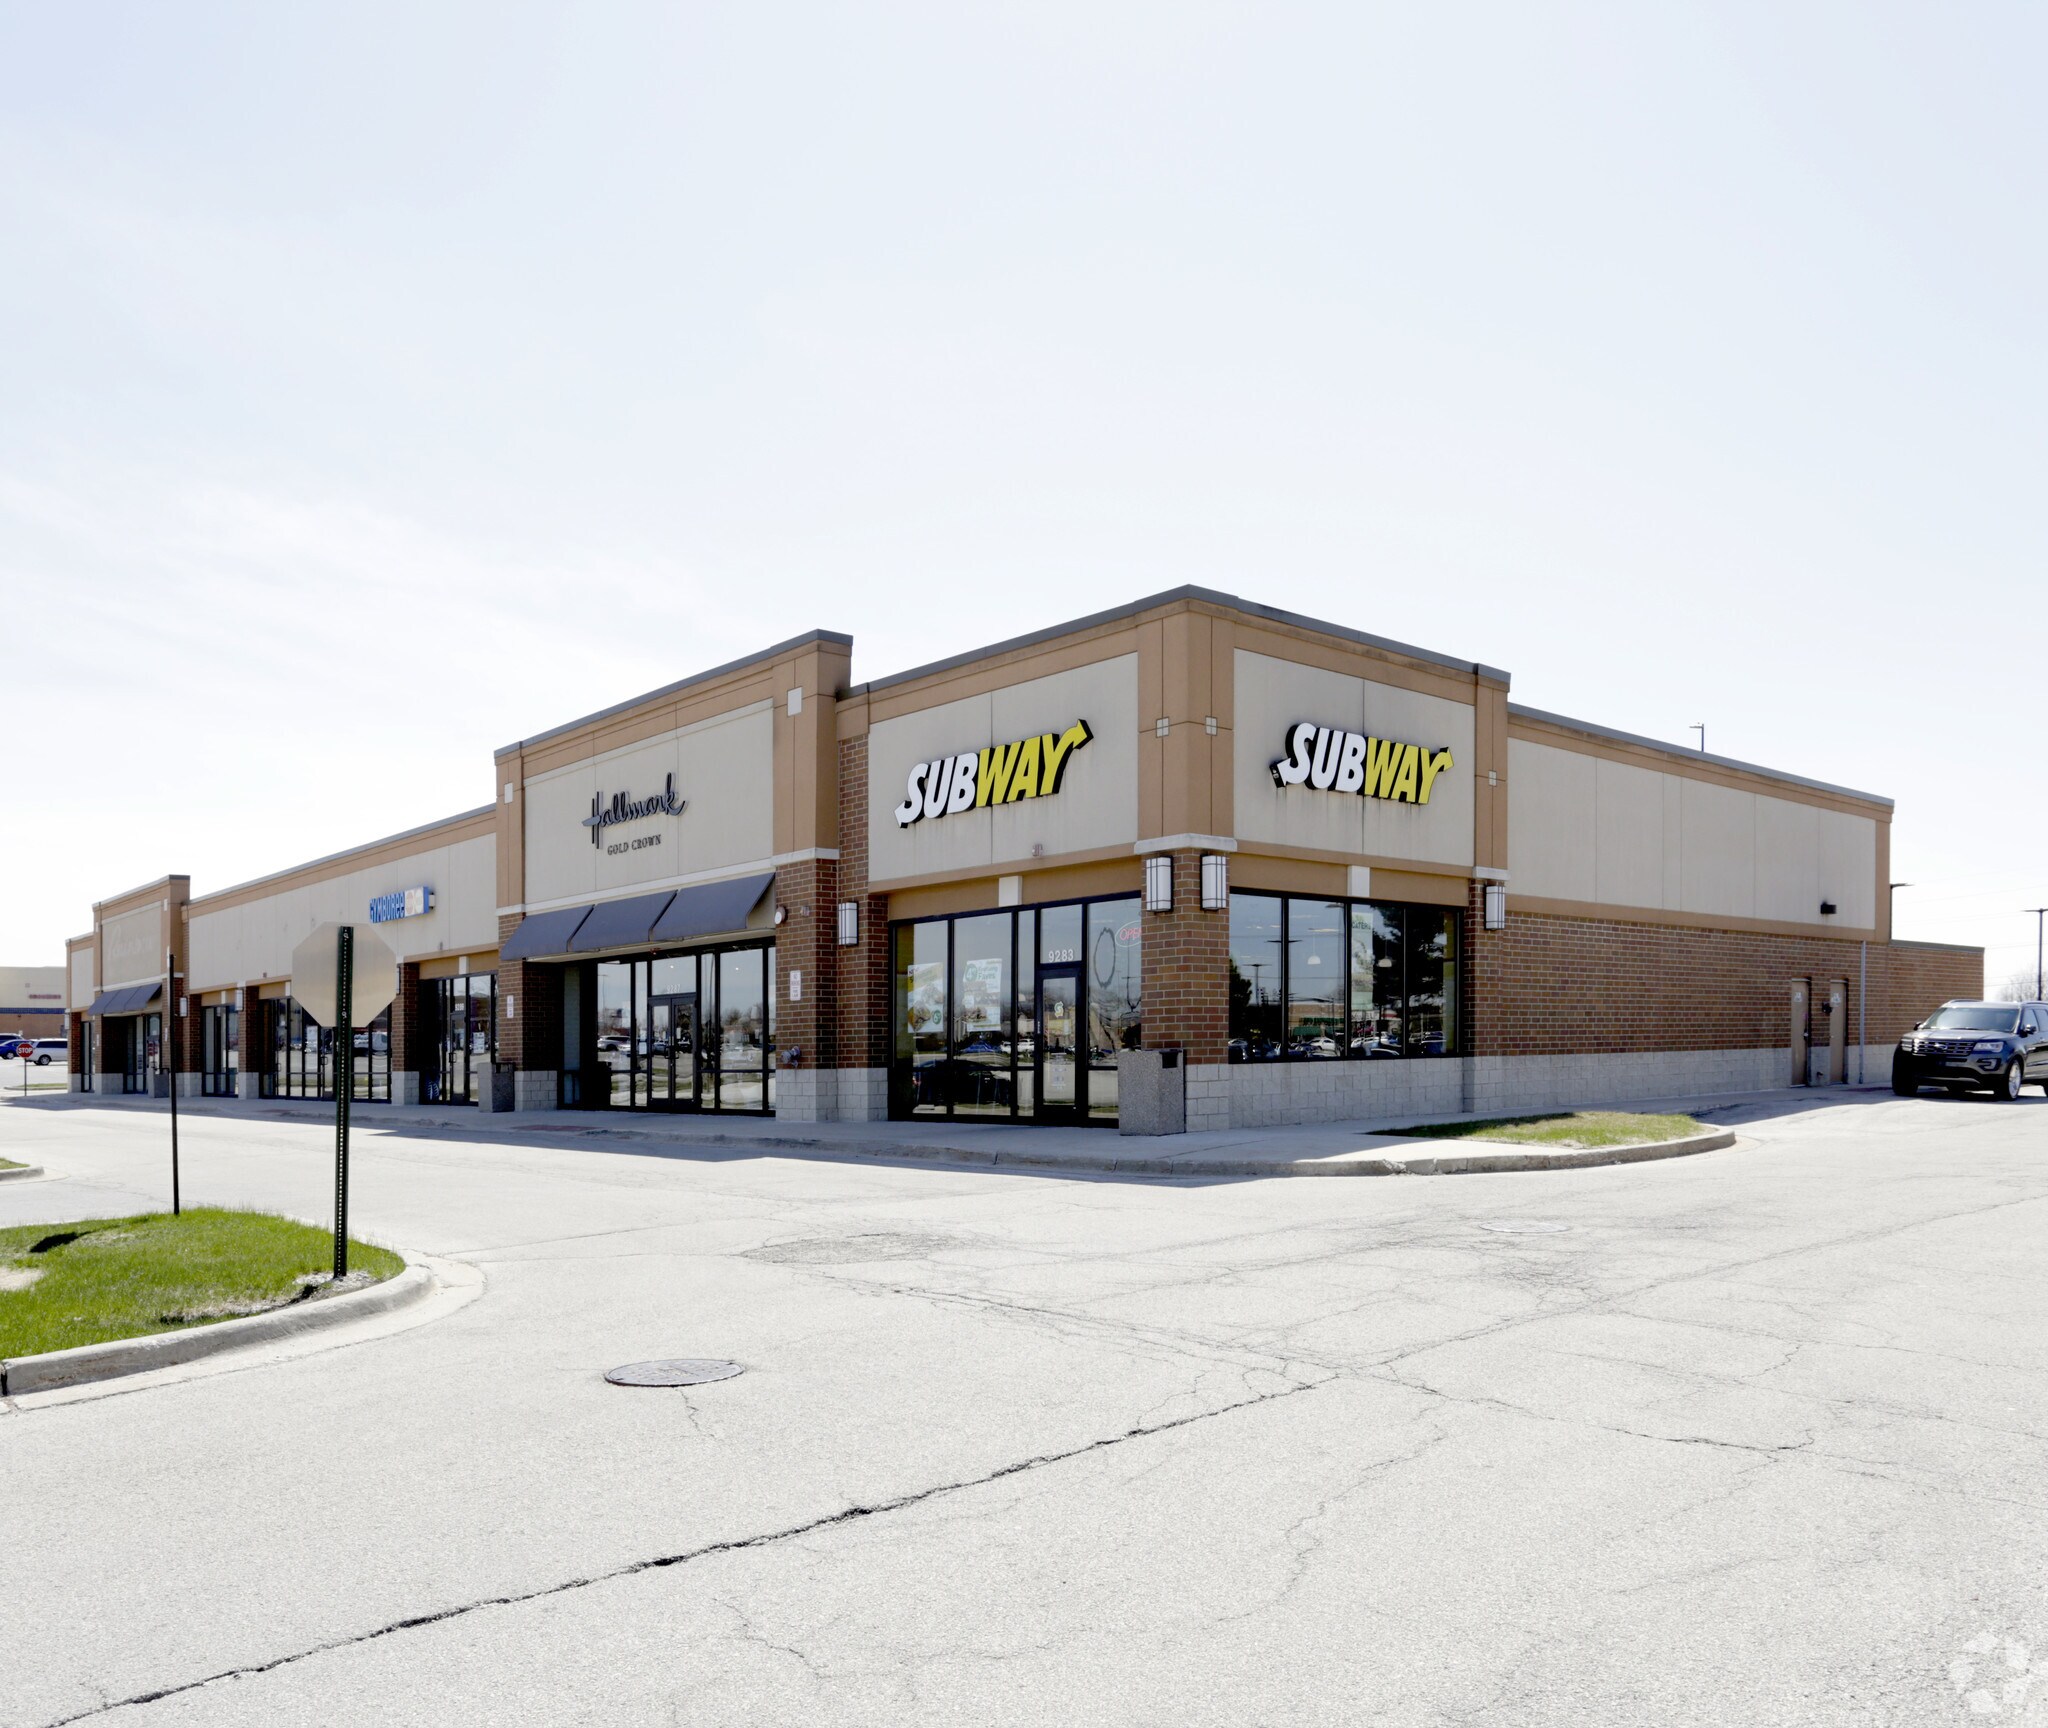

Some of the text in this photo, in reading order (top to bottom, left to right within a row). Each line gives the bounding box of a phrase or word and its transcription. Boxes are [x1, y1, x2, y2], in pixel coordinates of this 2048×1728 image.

[894, 719, 1093, 828] SUBWAY
[1270, 722, 1454, 805] SUBWAY
[581, 772, 686, 849] Hallmark
[607, 834, 662, 855] GOLD CROWN
[1048, 949, 1074, 963] 9283
[1119, 927, 1142, 941] OPE
